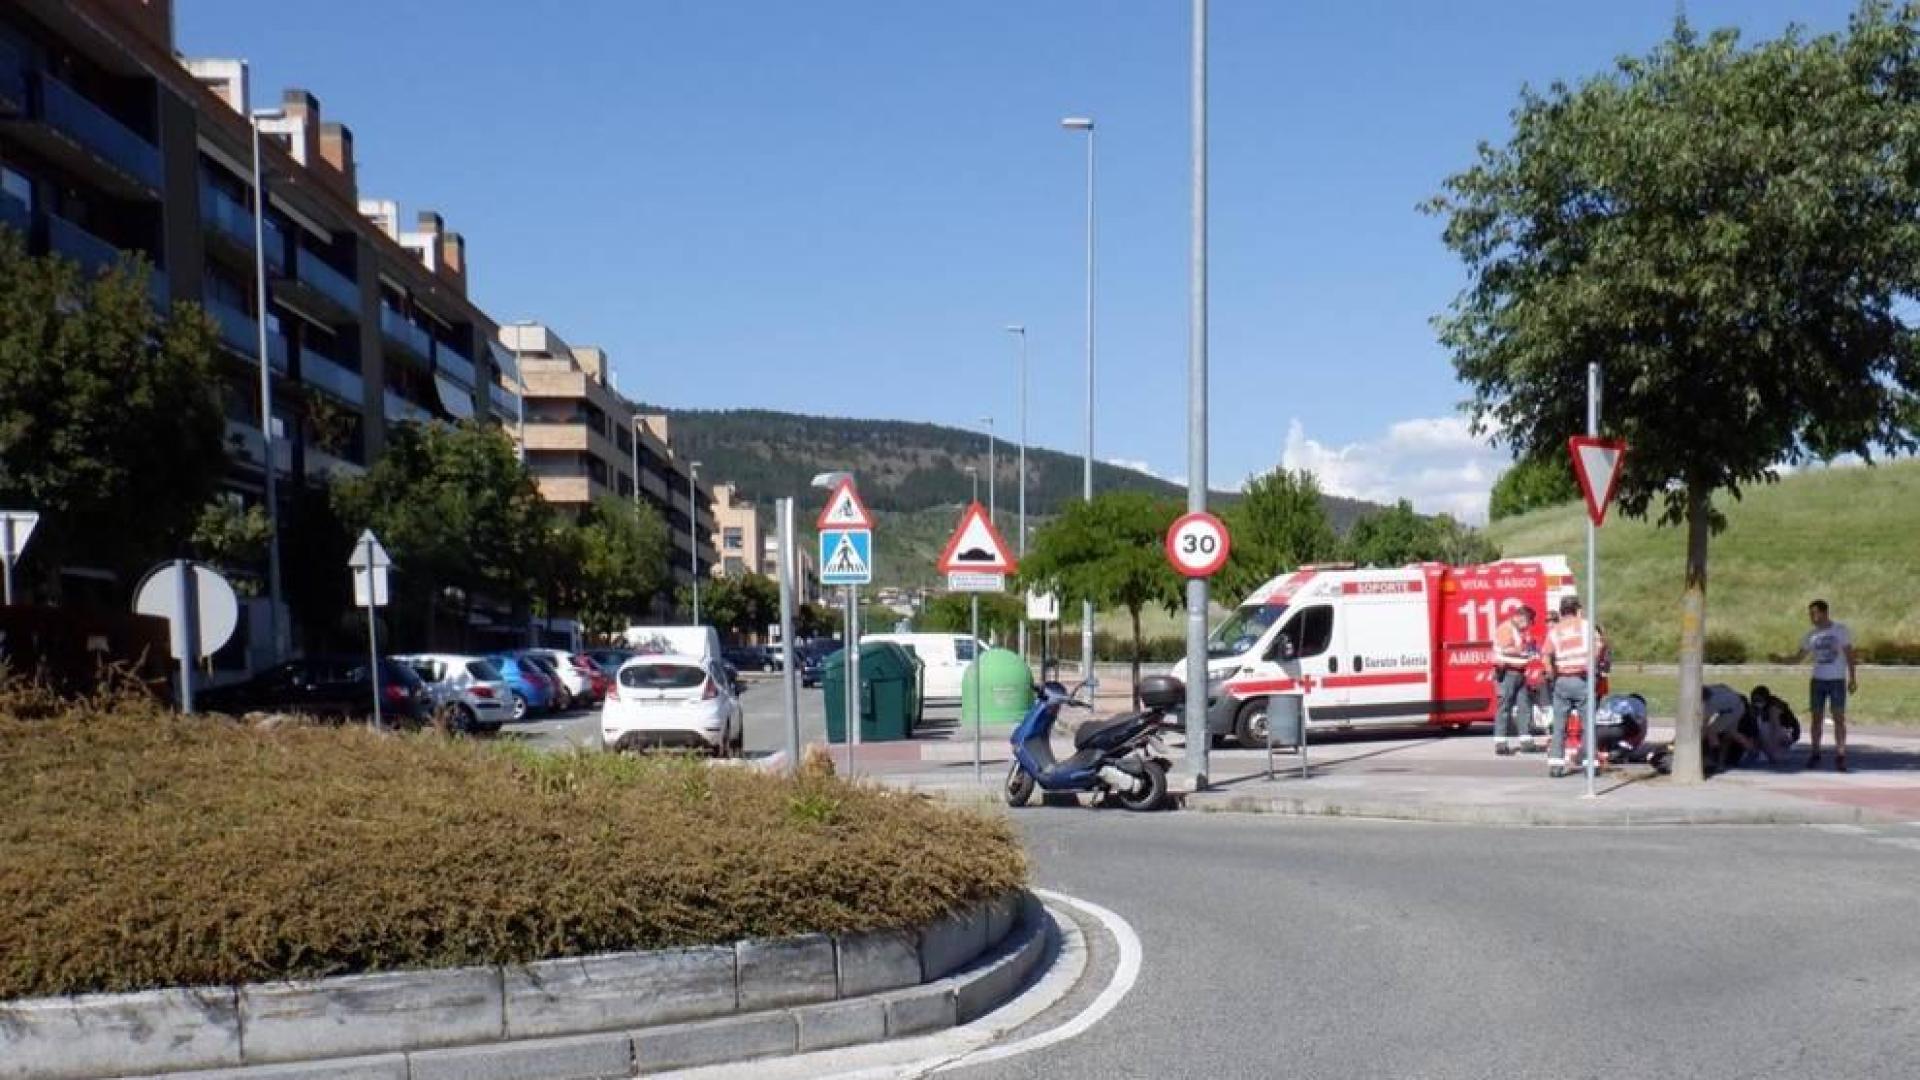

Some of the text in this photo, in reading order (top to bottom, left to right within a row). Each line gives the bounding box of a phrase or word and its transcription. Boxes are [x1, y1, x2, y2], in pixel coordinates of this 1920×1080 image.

[1183, 534, 1215, 554] 30
[1357, 581, 1410, 593] SOPORTE
[1461, 579, 1491, 590] VITAL
[1449, 650, 1493, 666] AMBU
